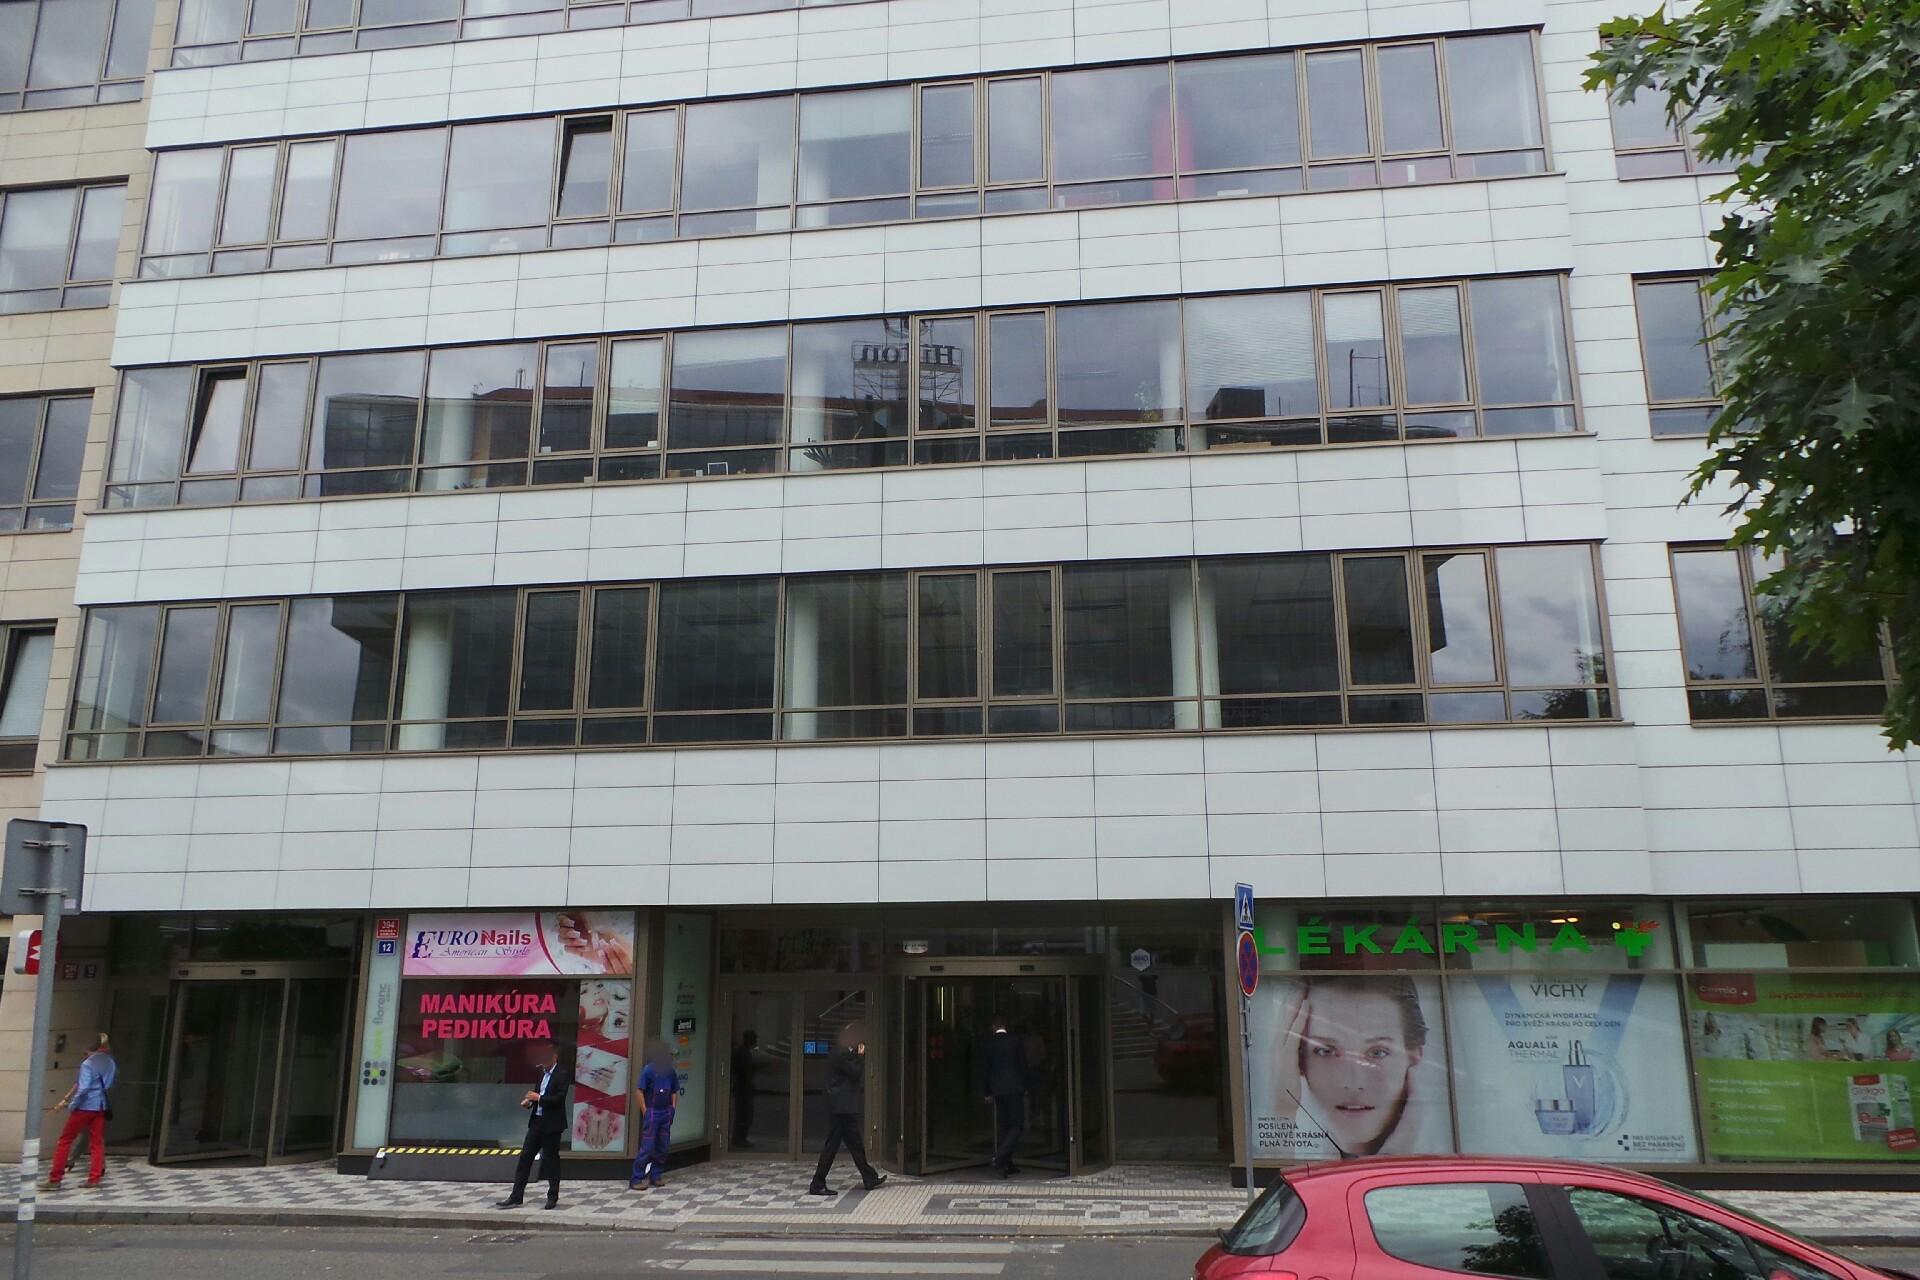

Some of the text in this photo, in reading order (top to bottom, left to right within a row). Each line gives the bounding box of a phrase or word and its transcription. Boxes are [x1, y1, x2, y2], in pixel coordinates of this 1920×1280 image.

[480, 930, 531, 945] Nails
[1255, 916, 1593, 955] LÉKÁRNA
[382, 943, 392, 952] 12
[1529, 984, 1587, 997] VICHY
[420, 989, 557, 1014] MANIKÚRA
[422, 1015, 551, 1039] PEDIKÚRA
[1507, 1040, 1559, 1049] AQUALIA
